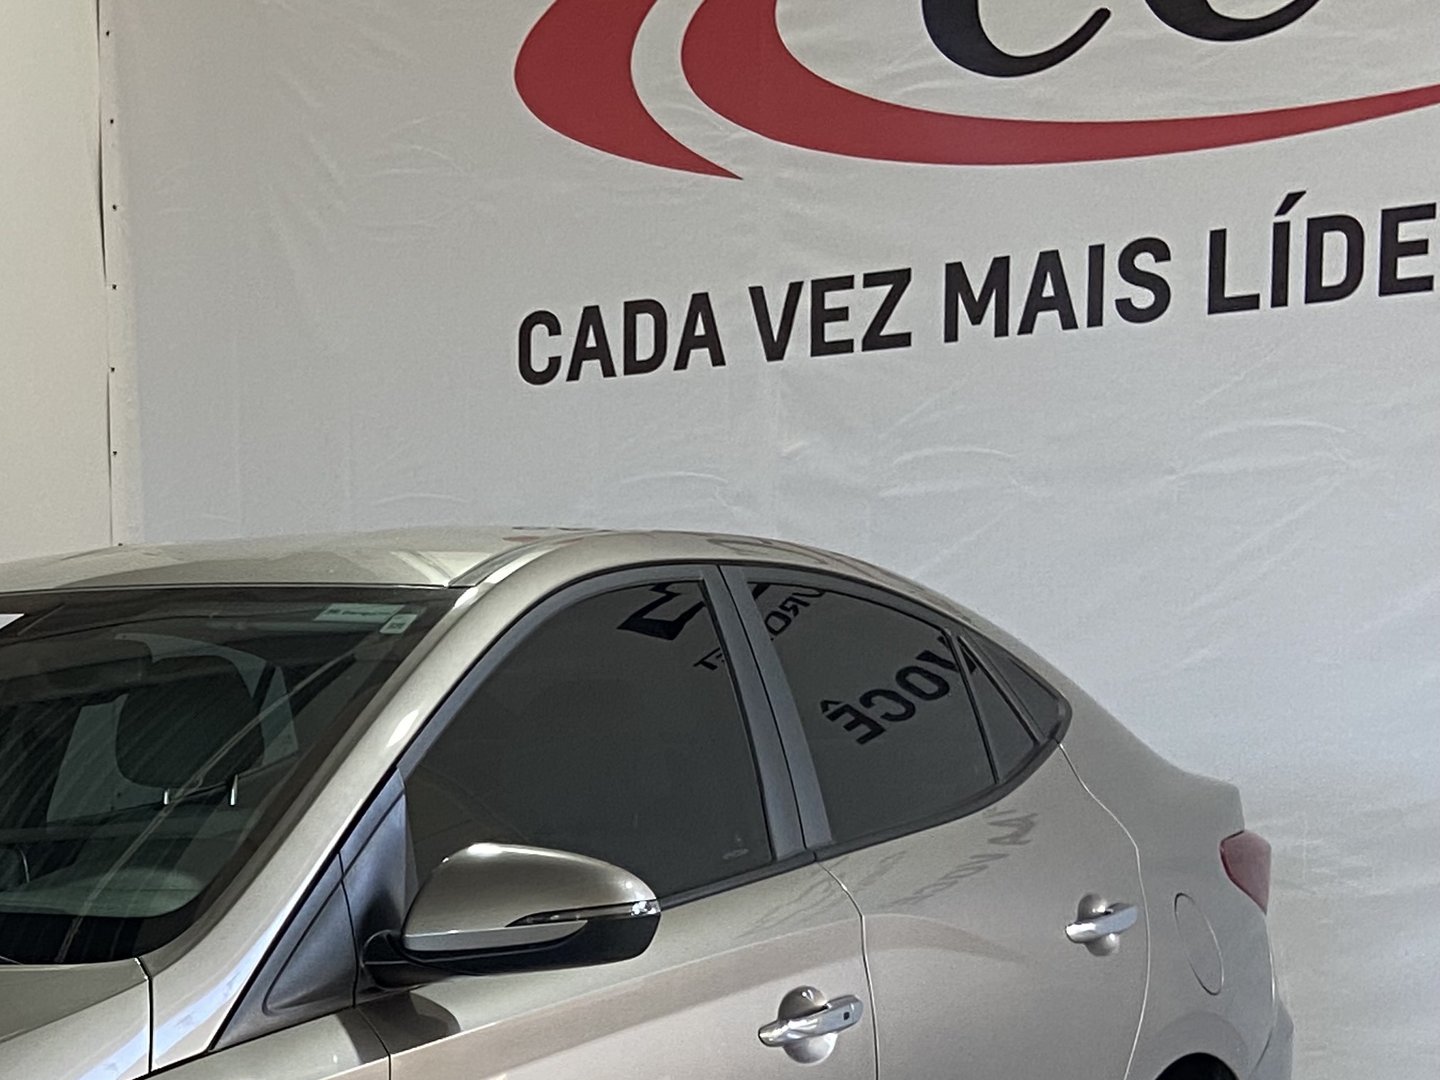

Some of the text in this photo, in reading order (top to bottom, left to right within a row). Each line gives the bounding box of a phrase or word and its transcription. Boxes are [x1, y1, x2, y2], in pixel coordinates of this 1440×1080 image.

[517, 291, 727, 386] CADA
[748, 267, 913, 362] VEZ
[943, 236, 1173, 344] MAIS
